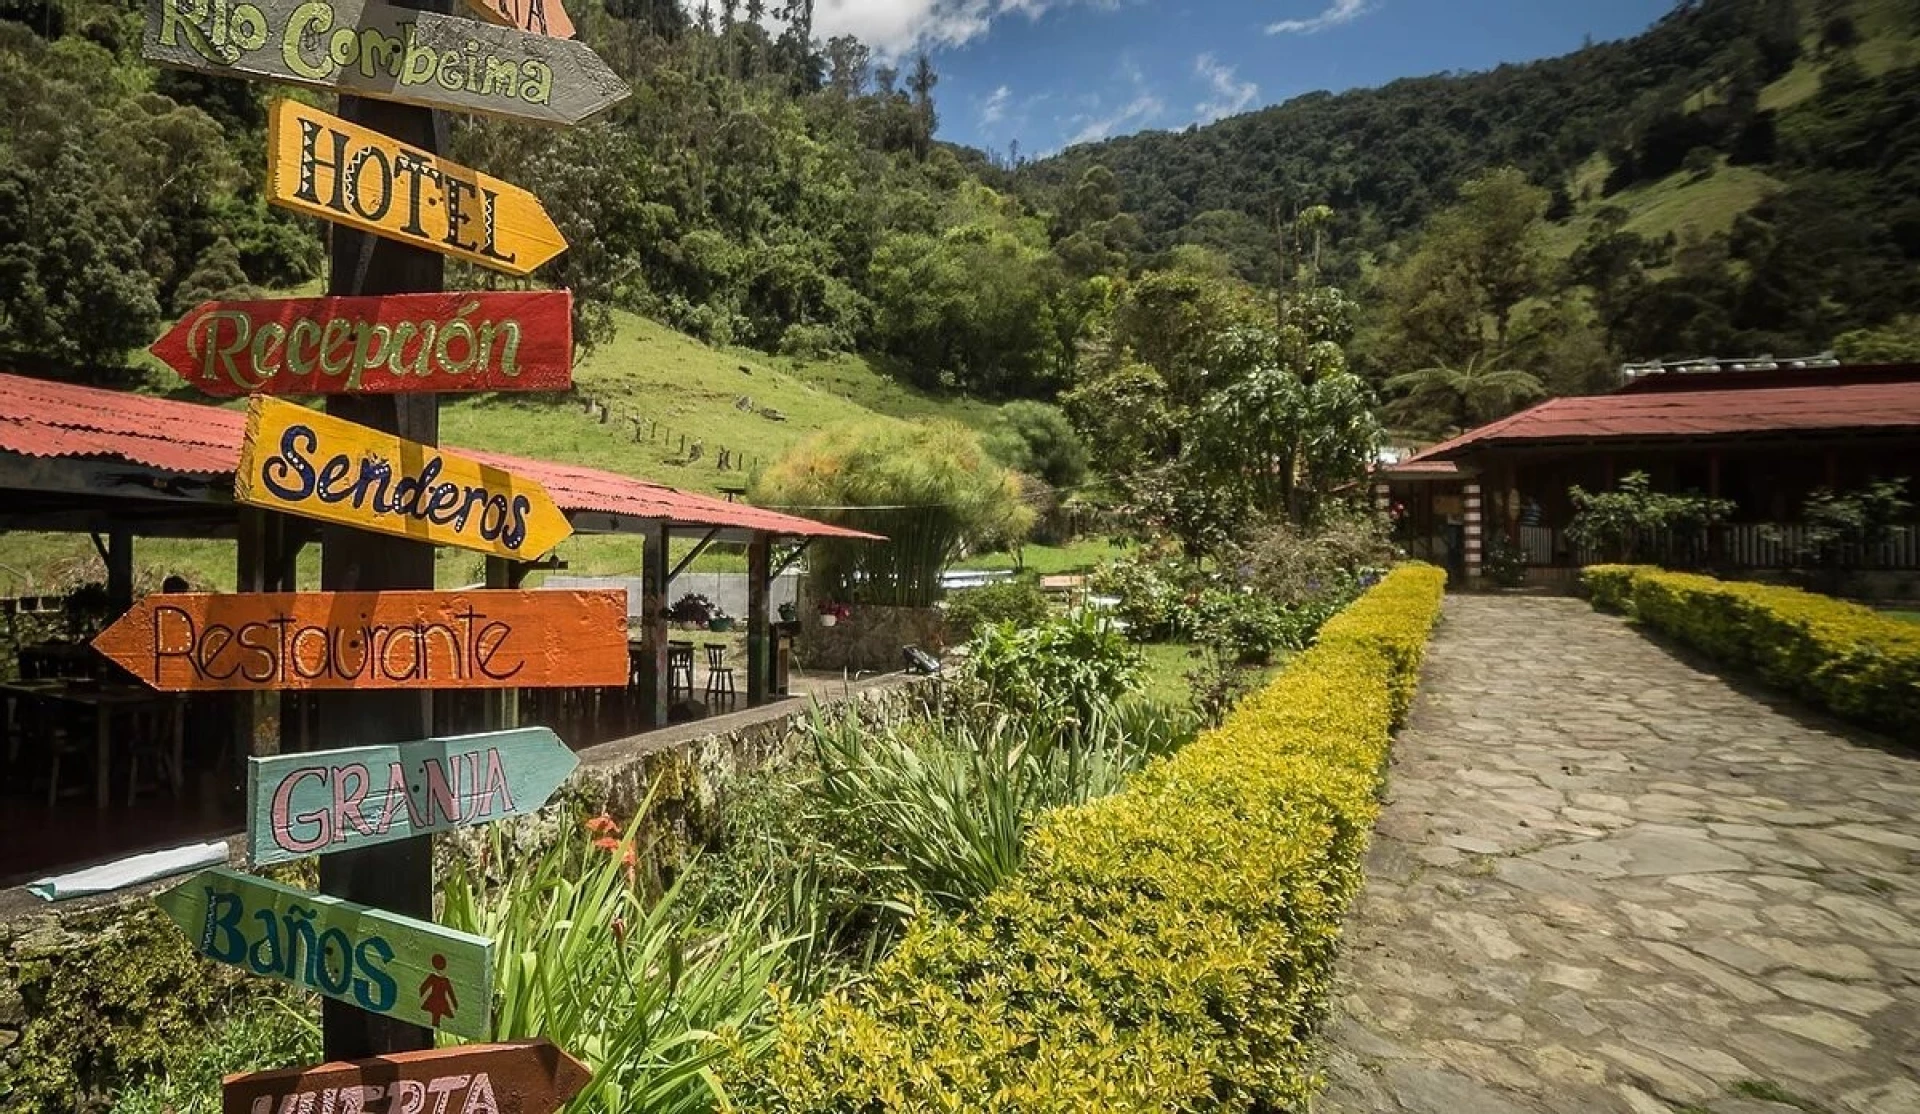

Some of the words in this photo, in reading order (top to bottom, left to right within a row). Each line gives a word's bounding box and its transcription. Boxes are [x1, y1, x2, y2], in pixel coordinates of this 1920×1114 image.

[283, 2, 553, 105] Combeima
[297, 117, 516, 264] HOTEL
[187, 301, 522, 390] Recepción
[261, 426, 531, 549] Senderos
[154, 604, 525, 682] Restaurante
[270, 747, 515, 853] GRANJA
[203, 887, 398, 1012] Baños
